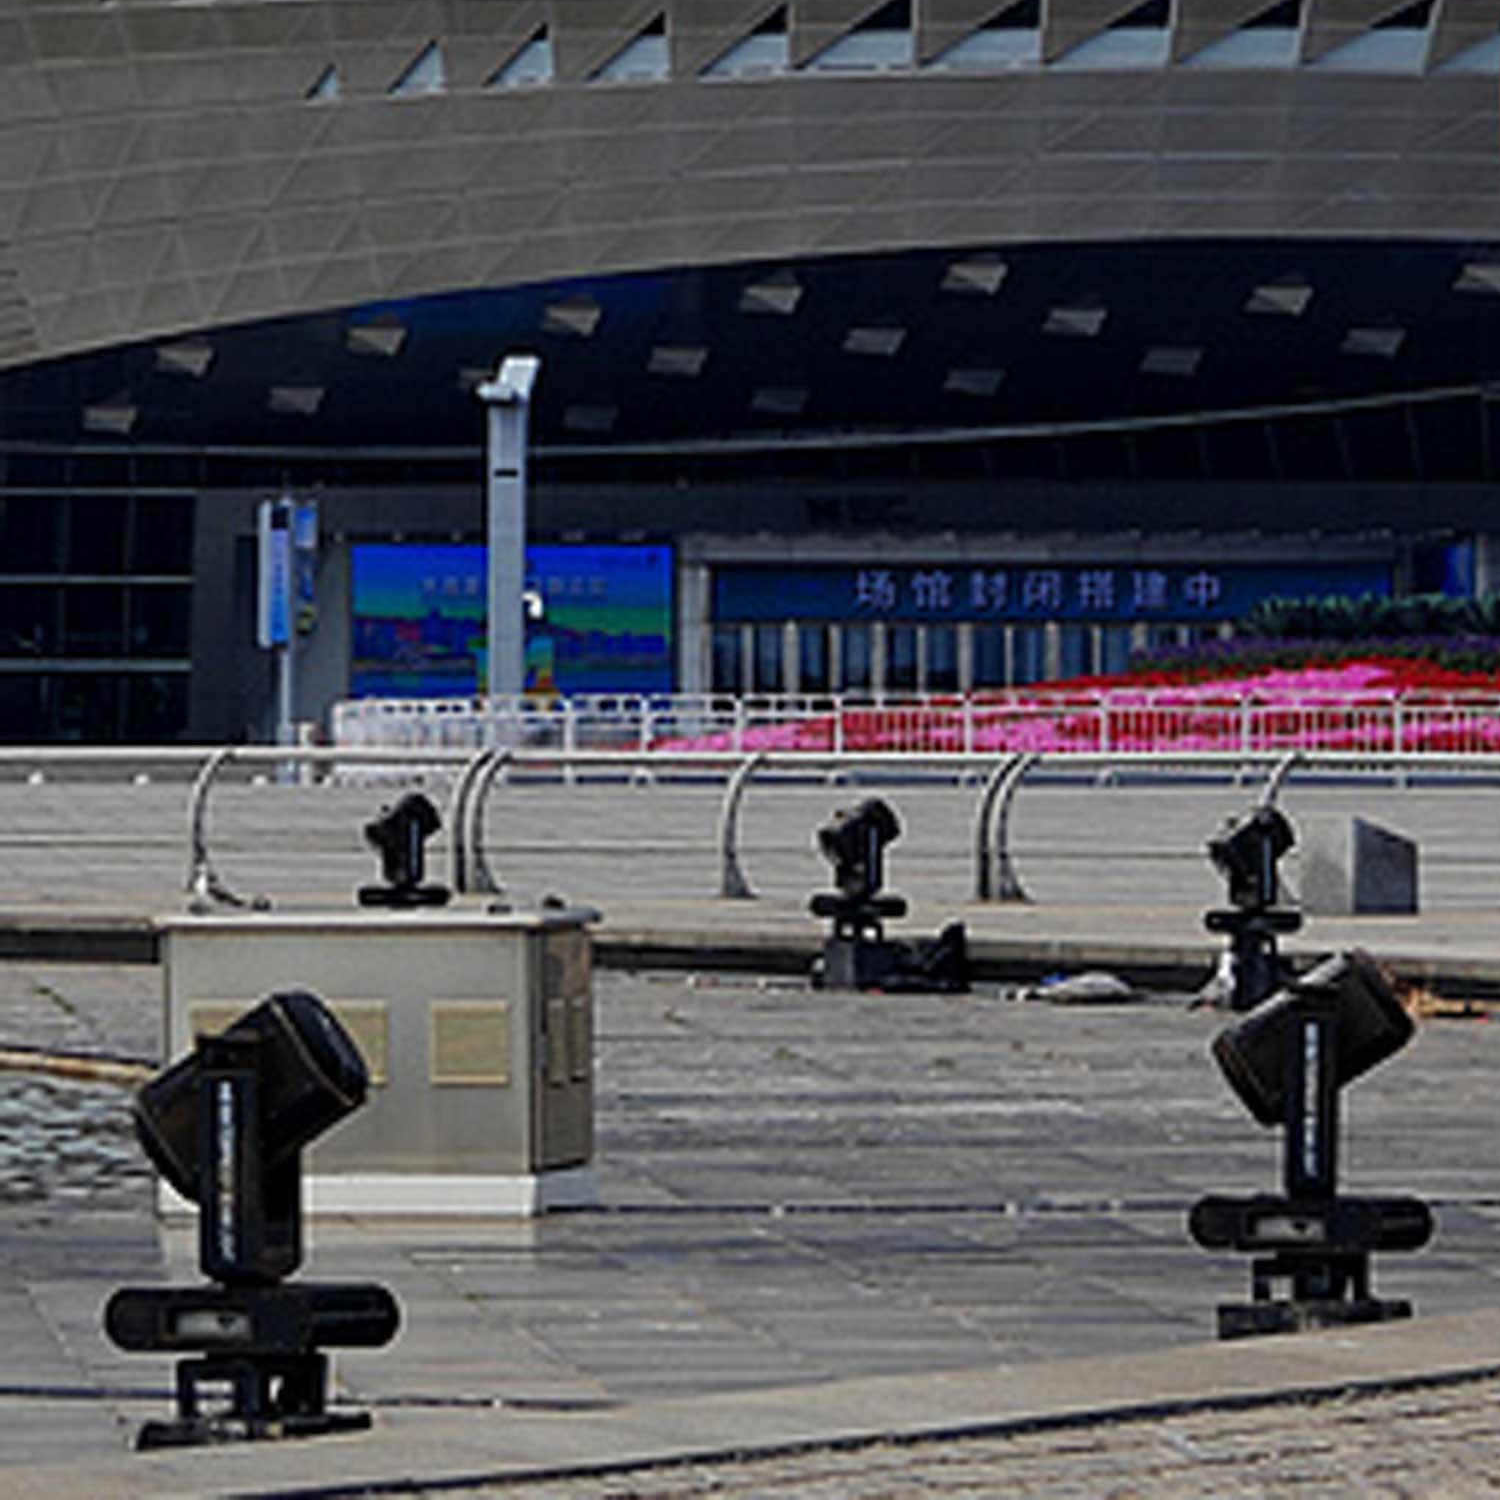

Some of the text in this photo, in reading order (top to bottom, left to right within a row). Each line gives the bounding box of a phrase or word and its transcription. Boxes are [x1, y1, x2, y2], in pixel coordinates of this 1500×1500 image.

[855, 569, 1222, 610] 场馆封闭搭建中
